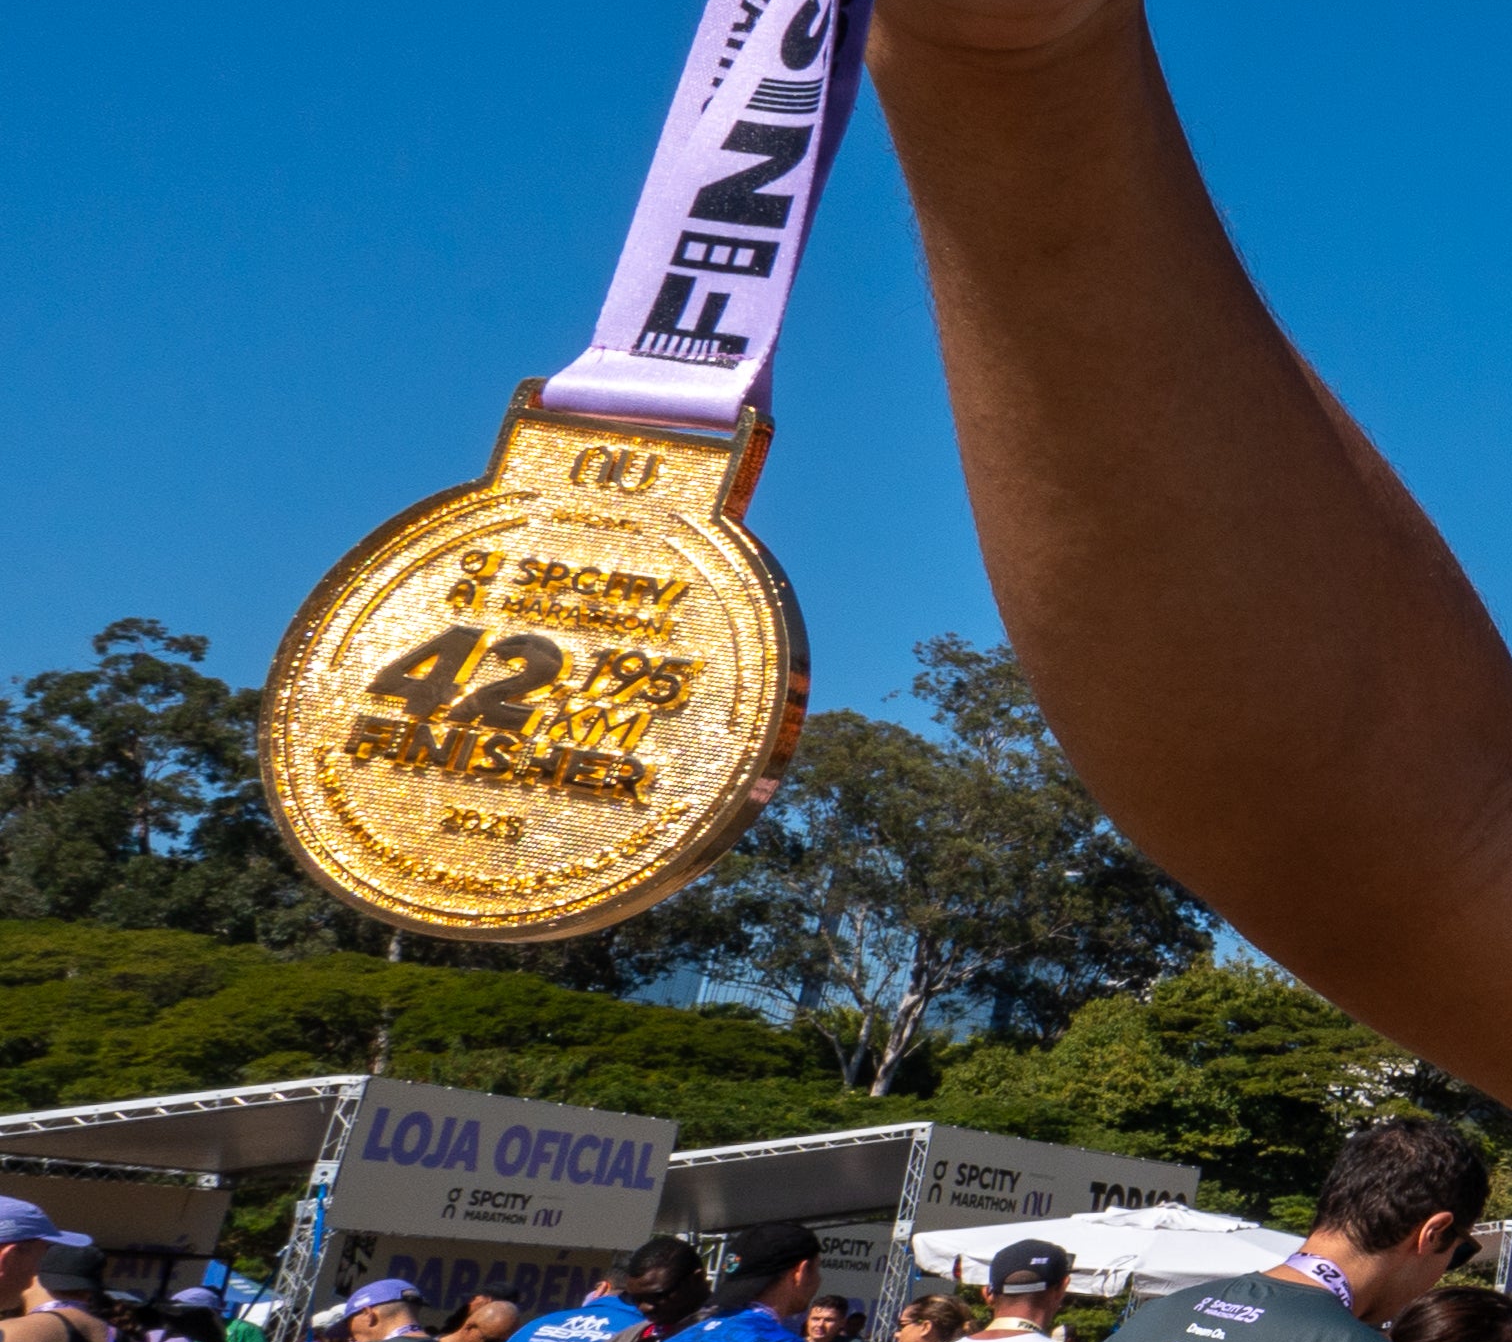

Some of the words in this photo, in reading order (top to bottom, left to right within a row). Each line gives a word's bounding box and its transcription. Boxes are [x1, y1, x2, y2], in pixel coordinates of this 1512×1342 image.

[513, 558, 688, 607] SPCITY
[501, 596, 673, 641] MARATHON
[345, 712, 657, 805] FINISHER
[362, 1107, 481, 1172] LOJA
[493, 1124, 655, 1190] OFICIAL
[954, 1164, 1022, 1192] SPCITY
[468, 1189, 533, 1210] SPCITY
[951, 1191, 1017, 1213] MARATHON
[463, 1210, 527, 1225] MARATHON
[820, 1237, 874, 1257] SPCITY
[1312, 1263, 1341, 1283] 25
[1234, 1306, 1265, 1323] 25
